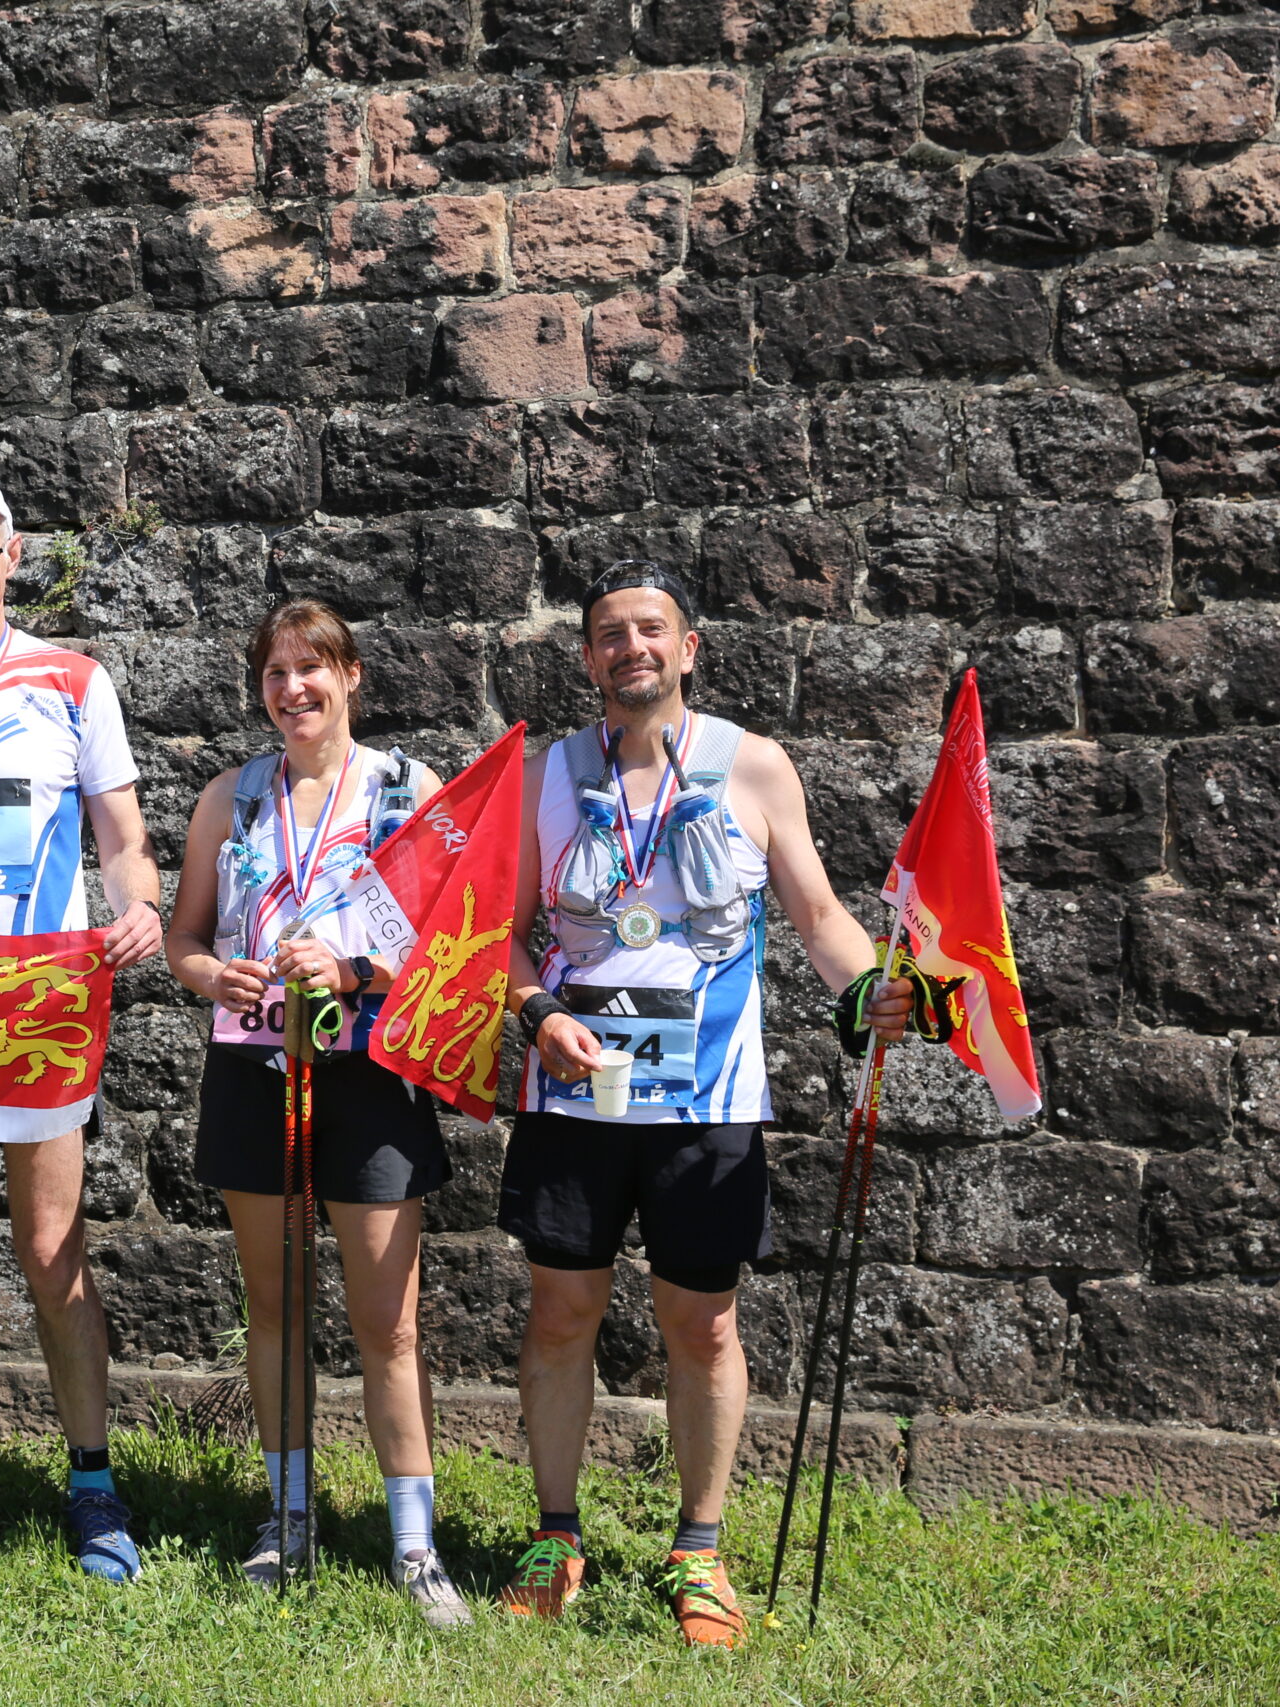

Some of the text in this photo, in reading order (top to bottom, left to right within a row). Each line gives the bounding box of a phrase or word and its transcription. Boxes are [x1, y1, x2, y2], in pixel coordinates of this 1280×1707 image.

[325, 846, 342, 863] STADE
[591, 1030, 665, 1067] 74
[571, 1083, 667, 1104] ALÉ
[870, 1066, 884, 1112] LEKI
